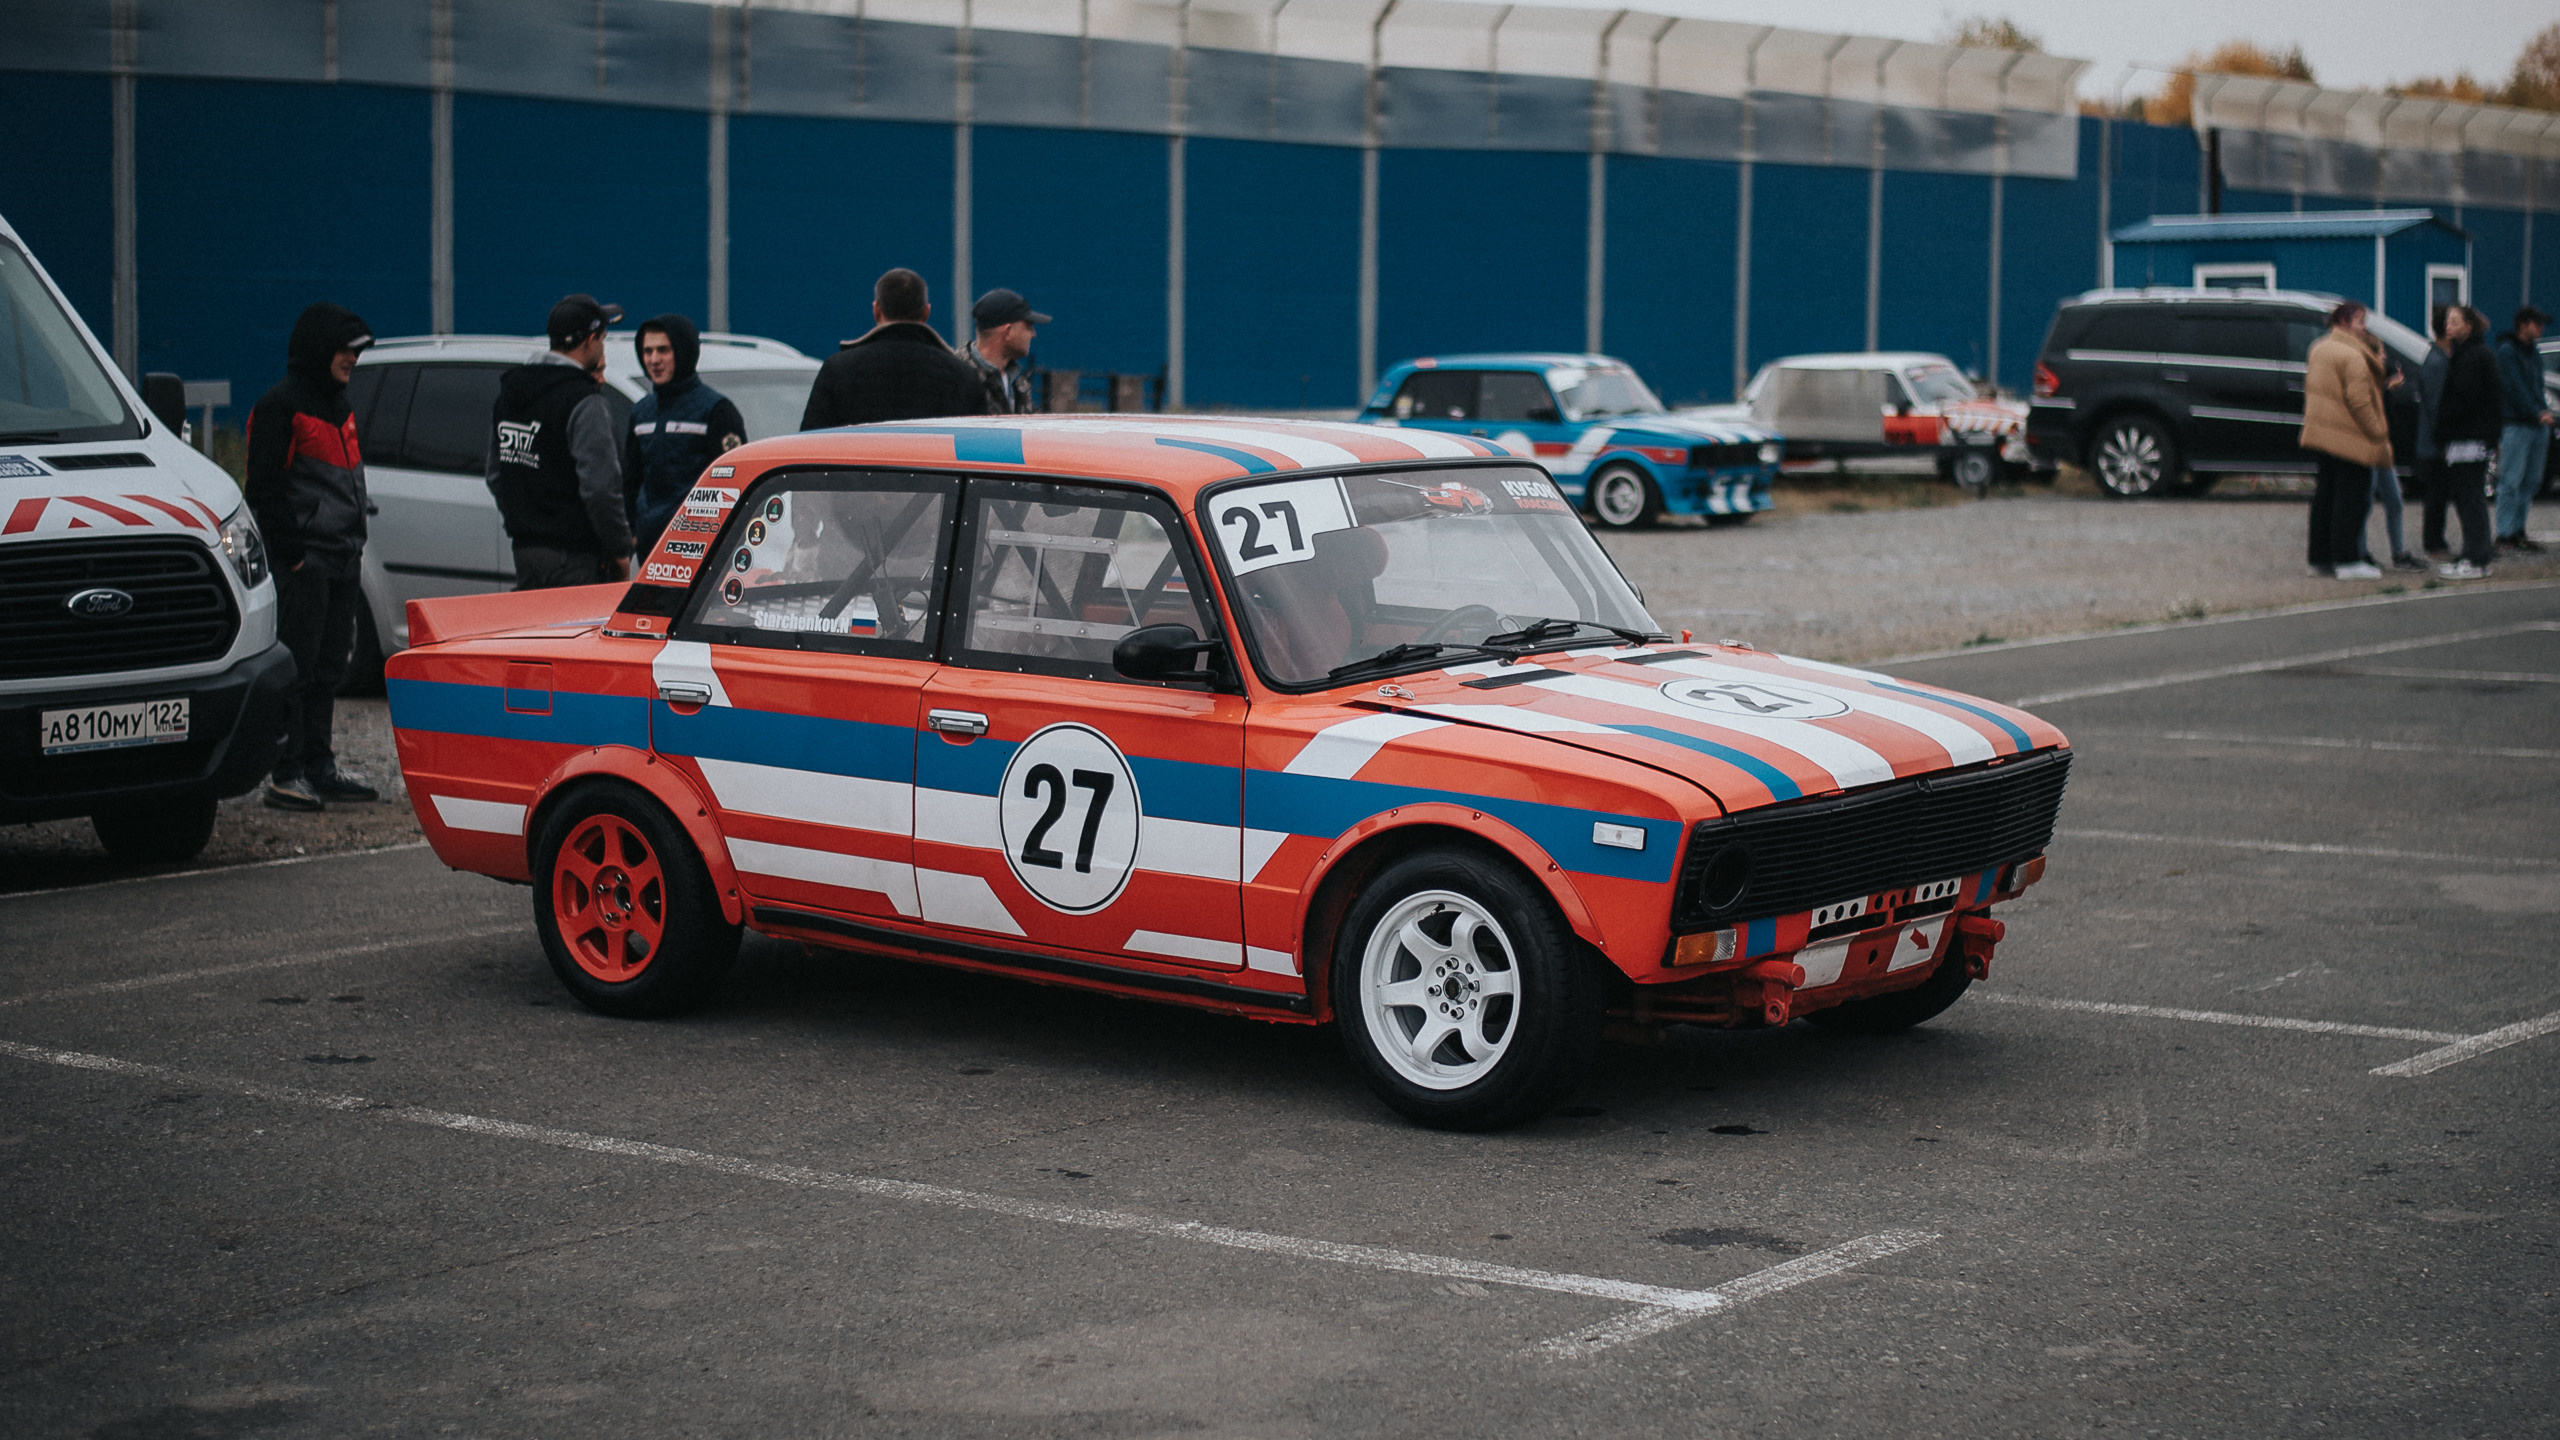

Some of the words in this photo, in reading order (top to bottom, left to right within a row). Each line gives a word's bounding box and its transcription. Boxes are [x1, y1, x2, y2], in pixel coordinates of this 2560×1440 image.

[687, 489, 721, 502] HAWK
[1500, 480, 1558, 500] КУБОК
[692, 508, 719, 516] YAMAHA
[1221, 500, 1305, 562] 27
[647, 562, 692, 582] sparco
[87, 594, 121, 613] Ford
[754, 610, 850, 634] Starchenkov.N
[1685, 684, 1813, 714] 27
[149, 702, 183, 726] 122
[156, 722, 173, 733] RUS
[1021, 762, 1115, 874] 27
